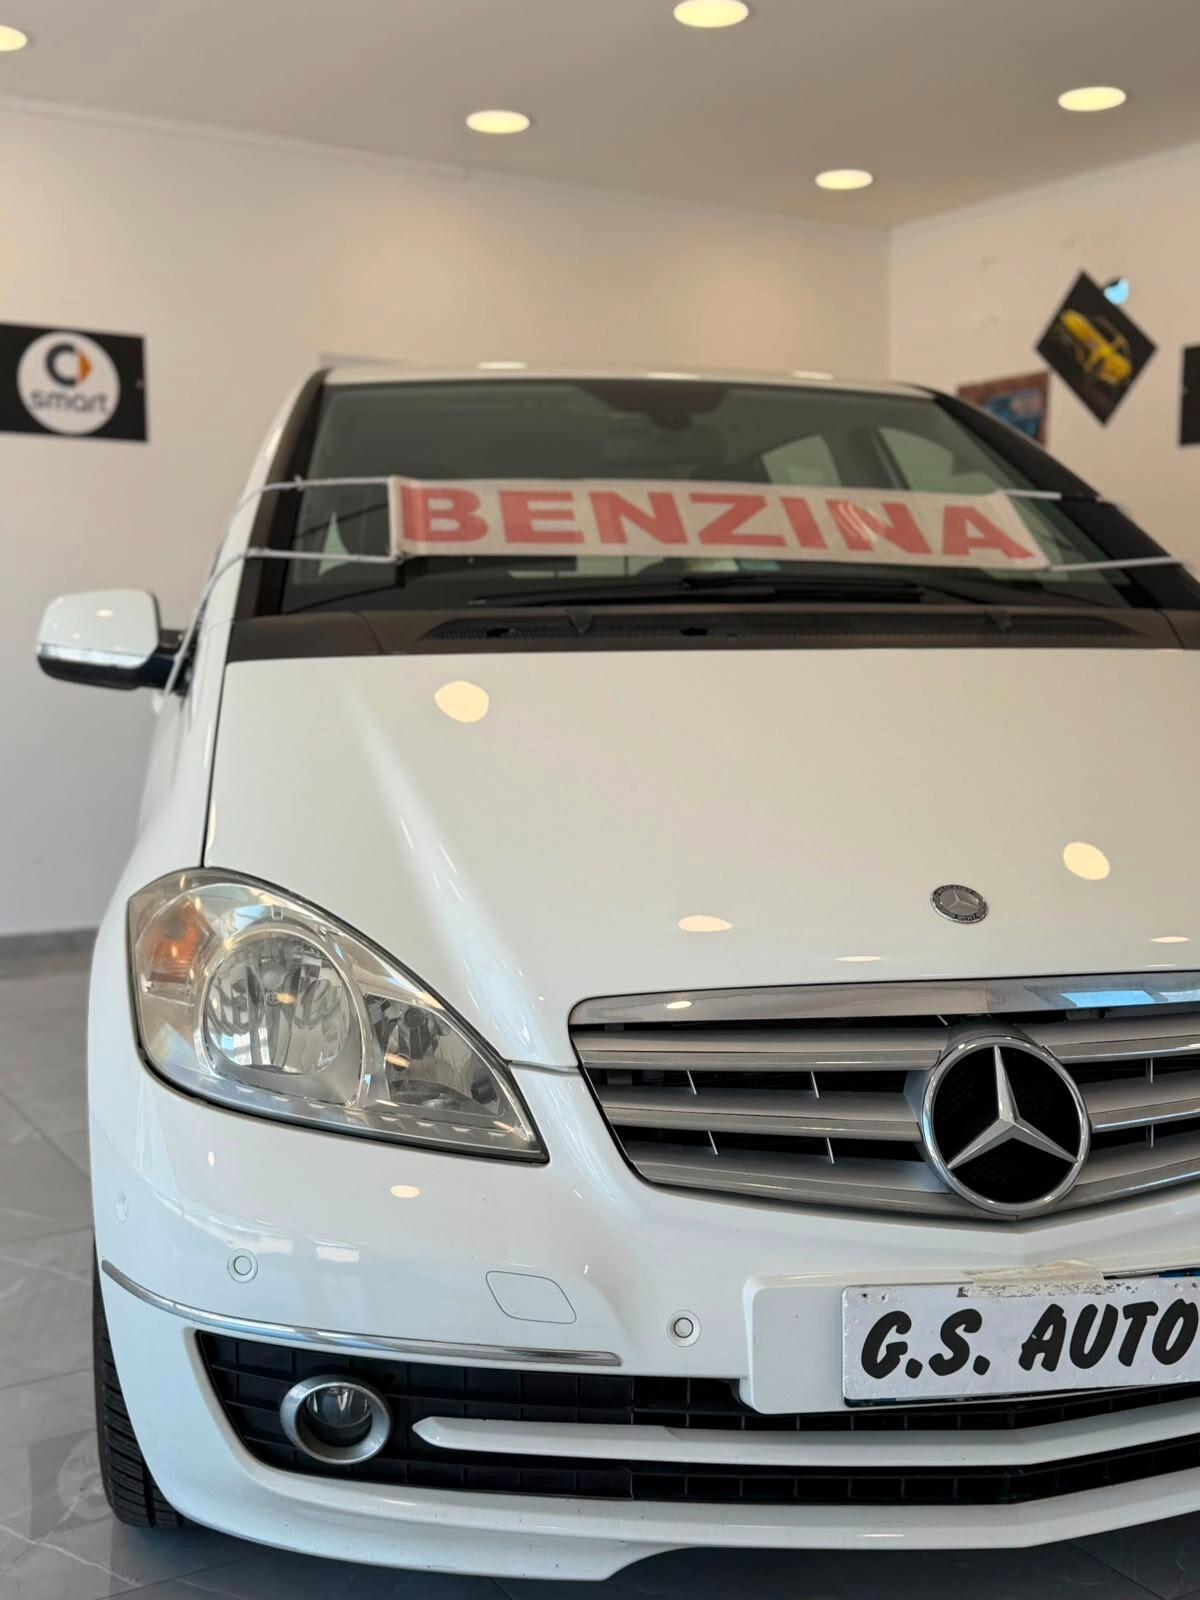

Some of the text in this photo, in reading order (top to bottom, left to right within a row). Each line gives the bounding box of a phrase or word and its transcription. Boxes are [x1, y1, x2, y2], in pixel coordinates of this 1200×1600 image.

[30, 389, 108, 413] smart
[401, 486, 1035, 559] BENZINA
[861, 1298, 1200, 1379] G.S. AUTO
